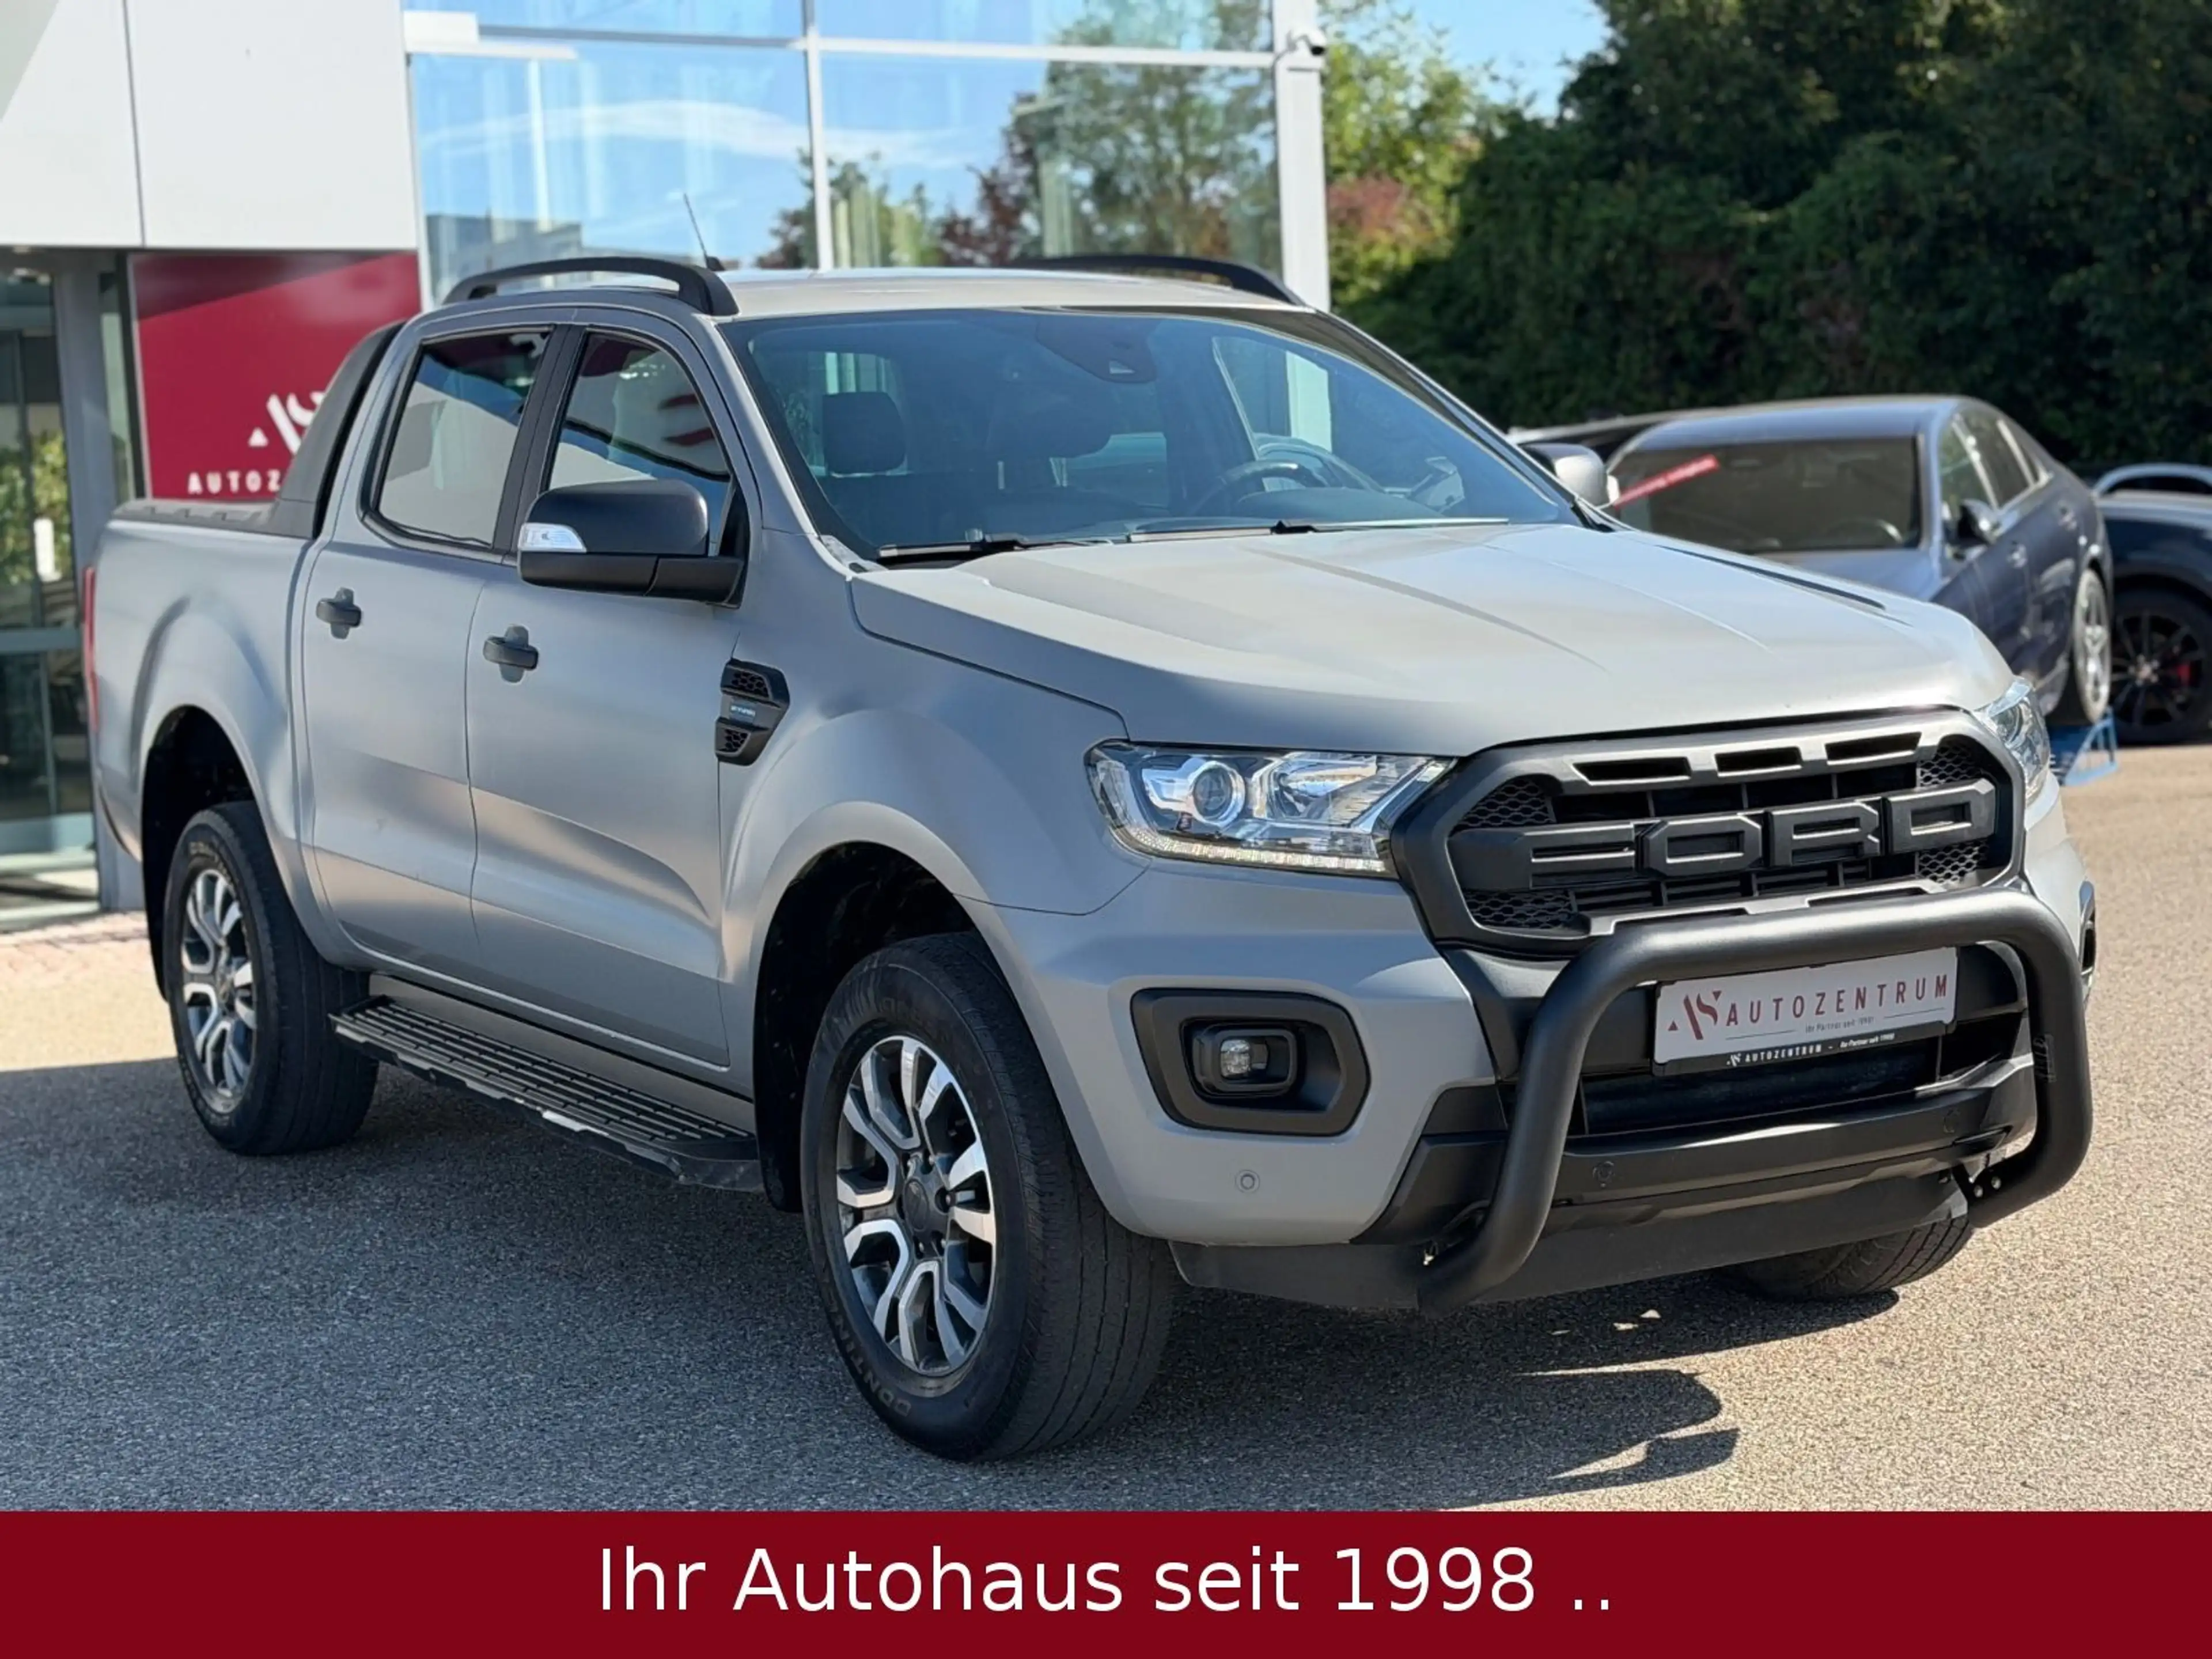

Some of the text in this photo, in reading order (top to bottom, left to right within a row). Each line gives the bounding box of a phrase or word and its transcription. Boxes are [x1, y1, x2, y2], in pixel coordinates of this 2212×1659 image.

[188, 469, 281, 495] AUTOZ
[1486, 778, 1995, 890] FORD
[1726, 974, 1948, 1027] AUTOZENTRUM
[1745, 1044, 1822, 1063] AUTOZENTRUM
